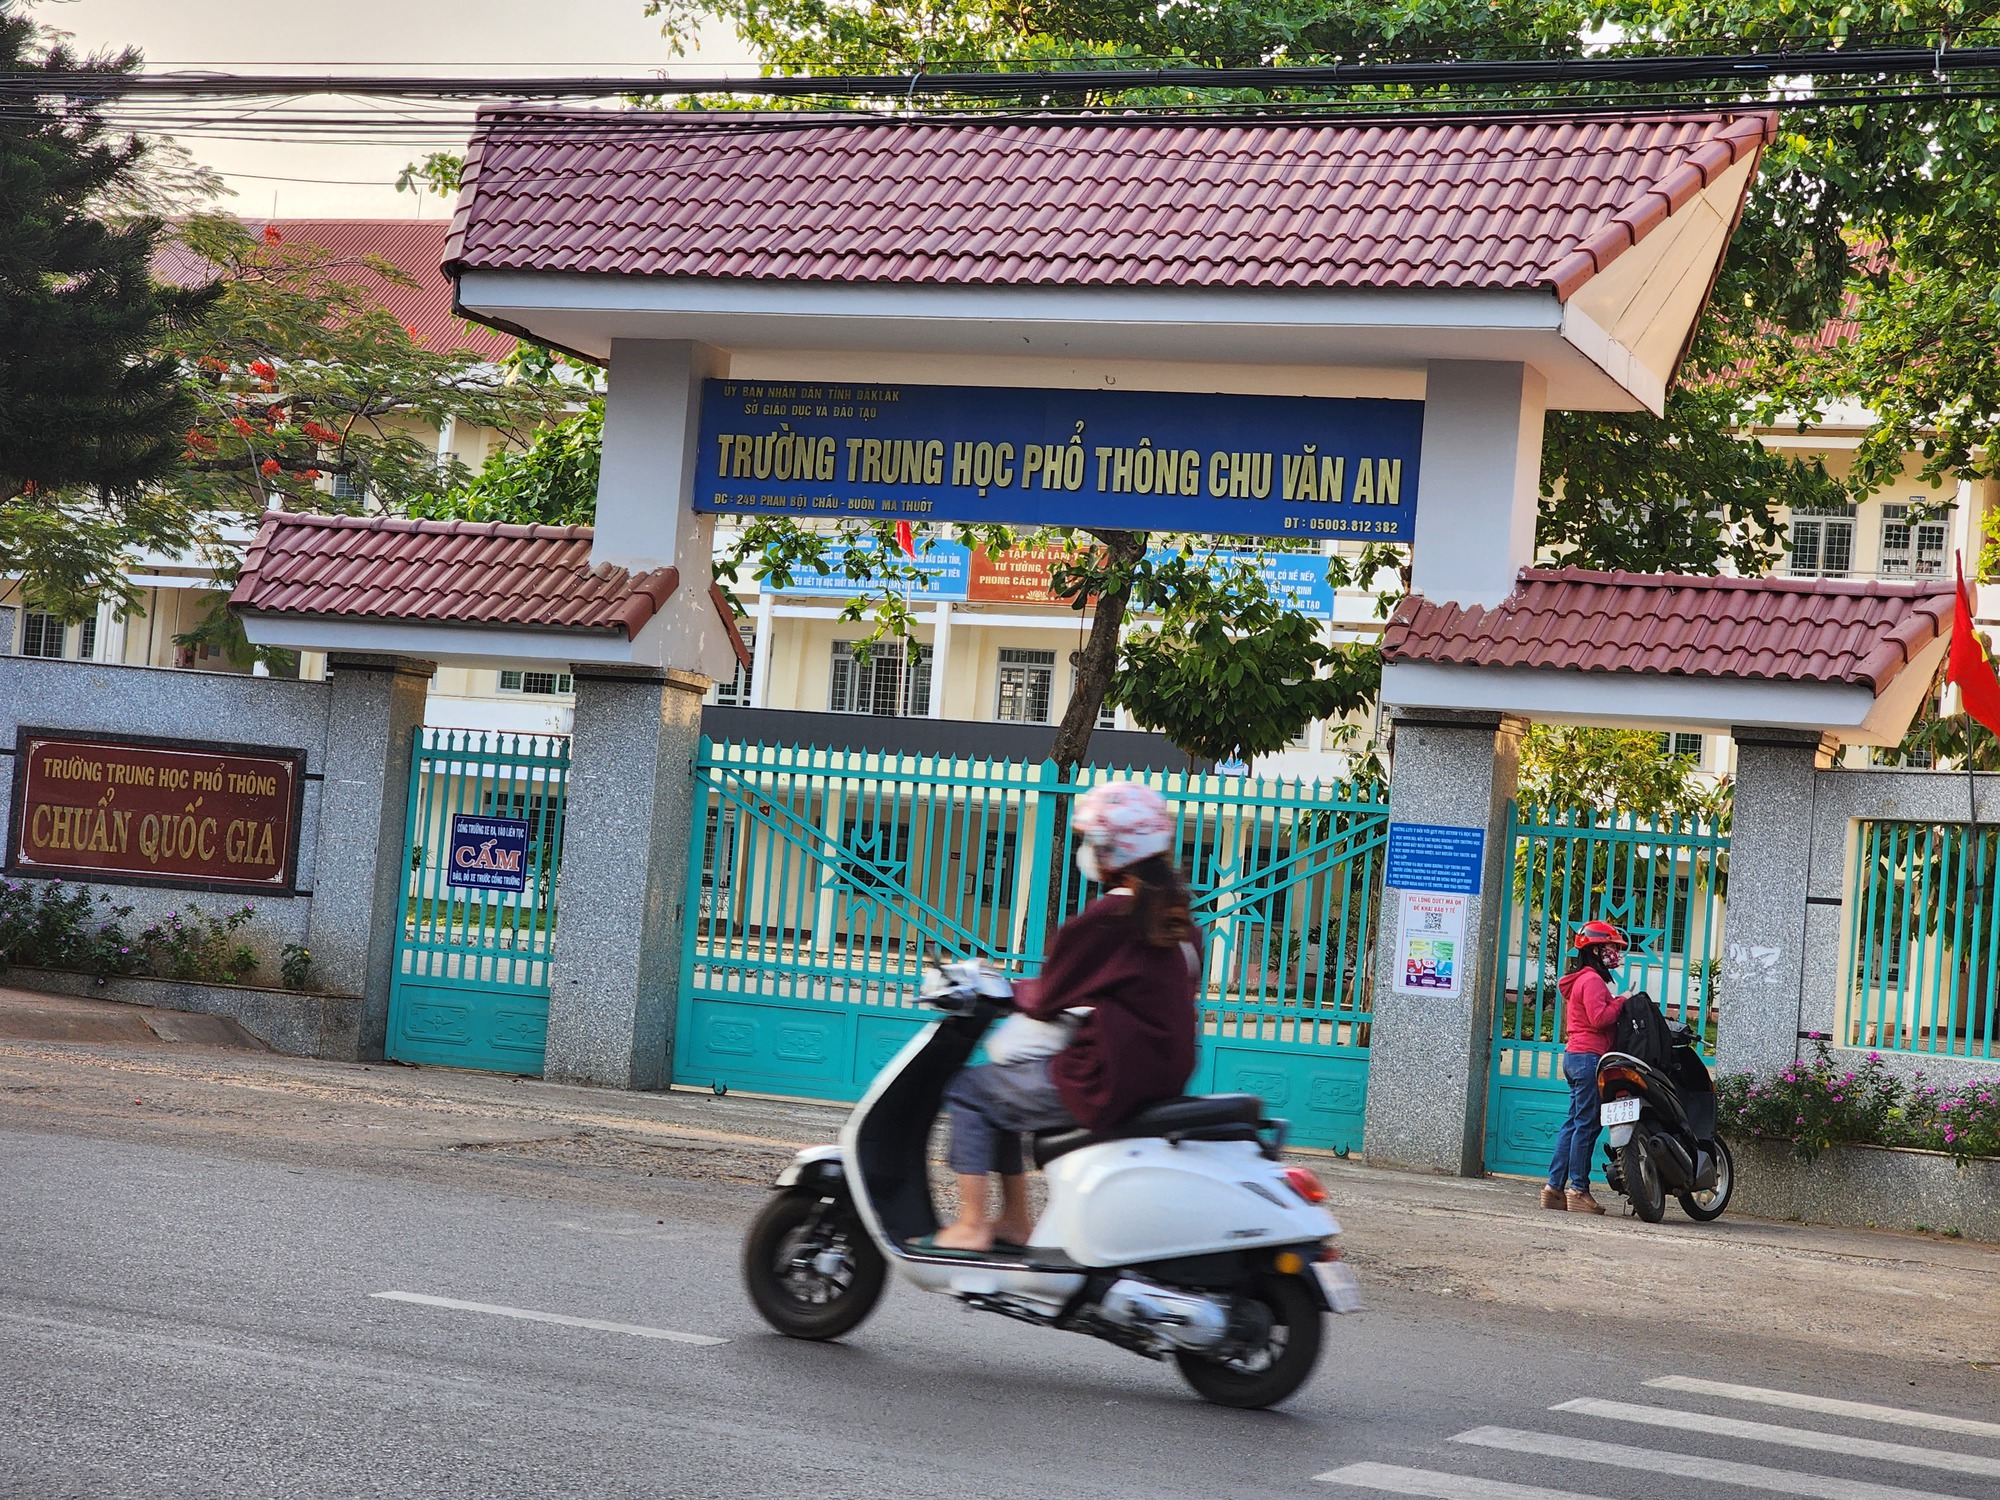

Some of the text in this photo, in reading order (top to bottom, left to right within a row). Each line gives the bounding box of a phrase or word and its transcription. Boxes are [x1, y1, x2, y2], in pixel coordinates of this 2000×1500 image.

[742, 385, 763, 398] BAN
[767, 385, 796, 399] NHÂN
[801, 387, 822, 400] DÂN
[828, 385, 851, 400] TỈNH
[744, 399, 877, 421] SỞ GIÁO DỤC VÀ ĐÀO TẠO
[717, 420, 1402, 505] TRƯỜNG TRUNG HỌC PHỔ THÔNG CHU VĂN AN
[714, 492, 728, 504] ĐC
[736, 493, 756, 506] 249
[760, 495, 786, 507] PHAN
[790, 493, 807, 511] BỘI
[848, 495, 875, 511] BUÔN
[881, 500, 898, 512] MA
[1284, 516, 1300, 529] ĐT
[1309, 518, 1372, 533] 05003.812
[1375, 521, 1398, 534] 382
[937, 552, 948, 564] CỦA
[1008, 548, 1028, 560] TẬP
[994, 561, 1008, 571] TƯ
[1010, 560, 1044, 574] TƯỞNG,
[1277, 568, 1287, 580] CÓ
[979, 575, 1010, 585] PHONG
[1012, 575, 1038, 586] CÁCH
[1296, 585, 1312, 596] SINH
[1306, 600, 1320, 611] TẠO
[43, 755, 277, 797] TRƯỜNG TRUNG HỌC PHỔ THÔNG
[31, 787, 132, 854] CHUẨN
[138, 796, 217, 864] QUỐC
[456, 818, 468, 833] CỔNG
[484, 825, 490, 835] XE
[455, 838, 521, 872] CẤM
[470, 873, 476, 882] XE
[1606, 1110, 1634, 1123] 5429
